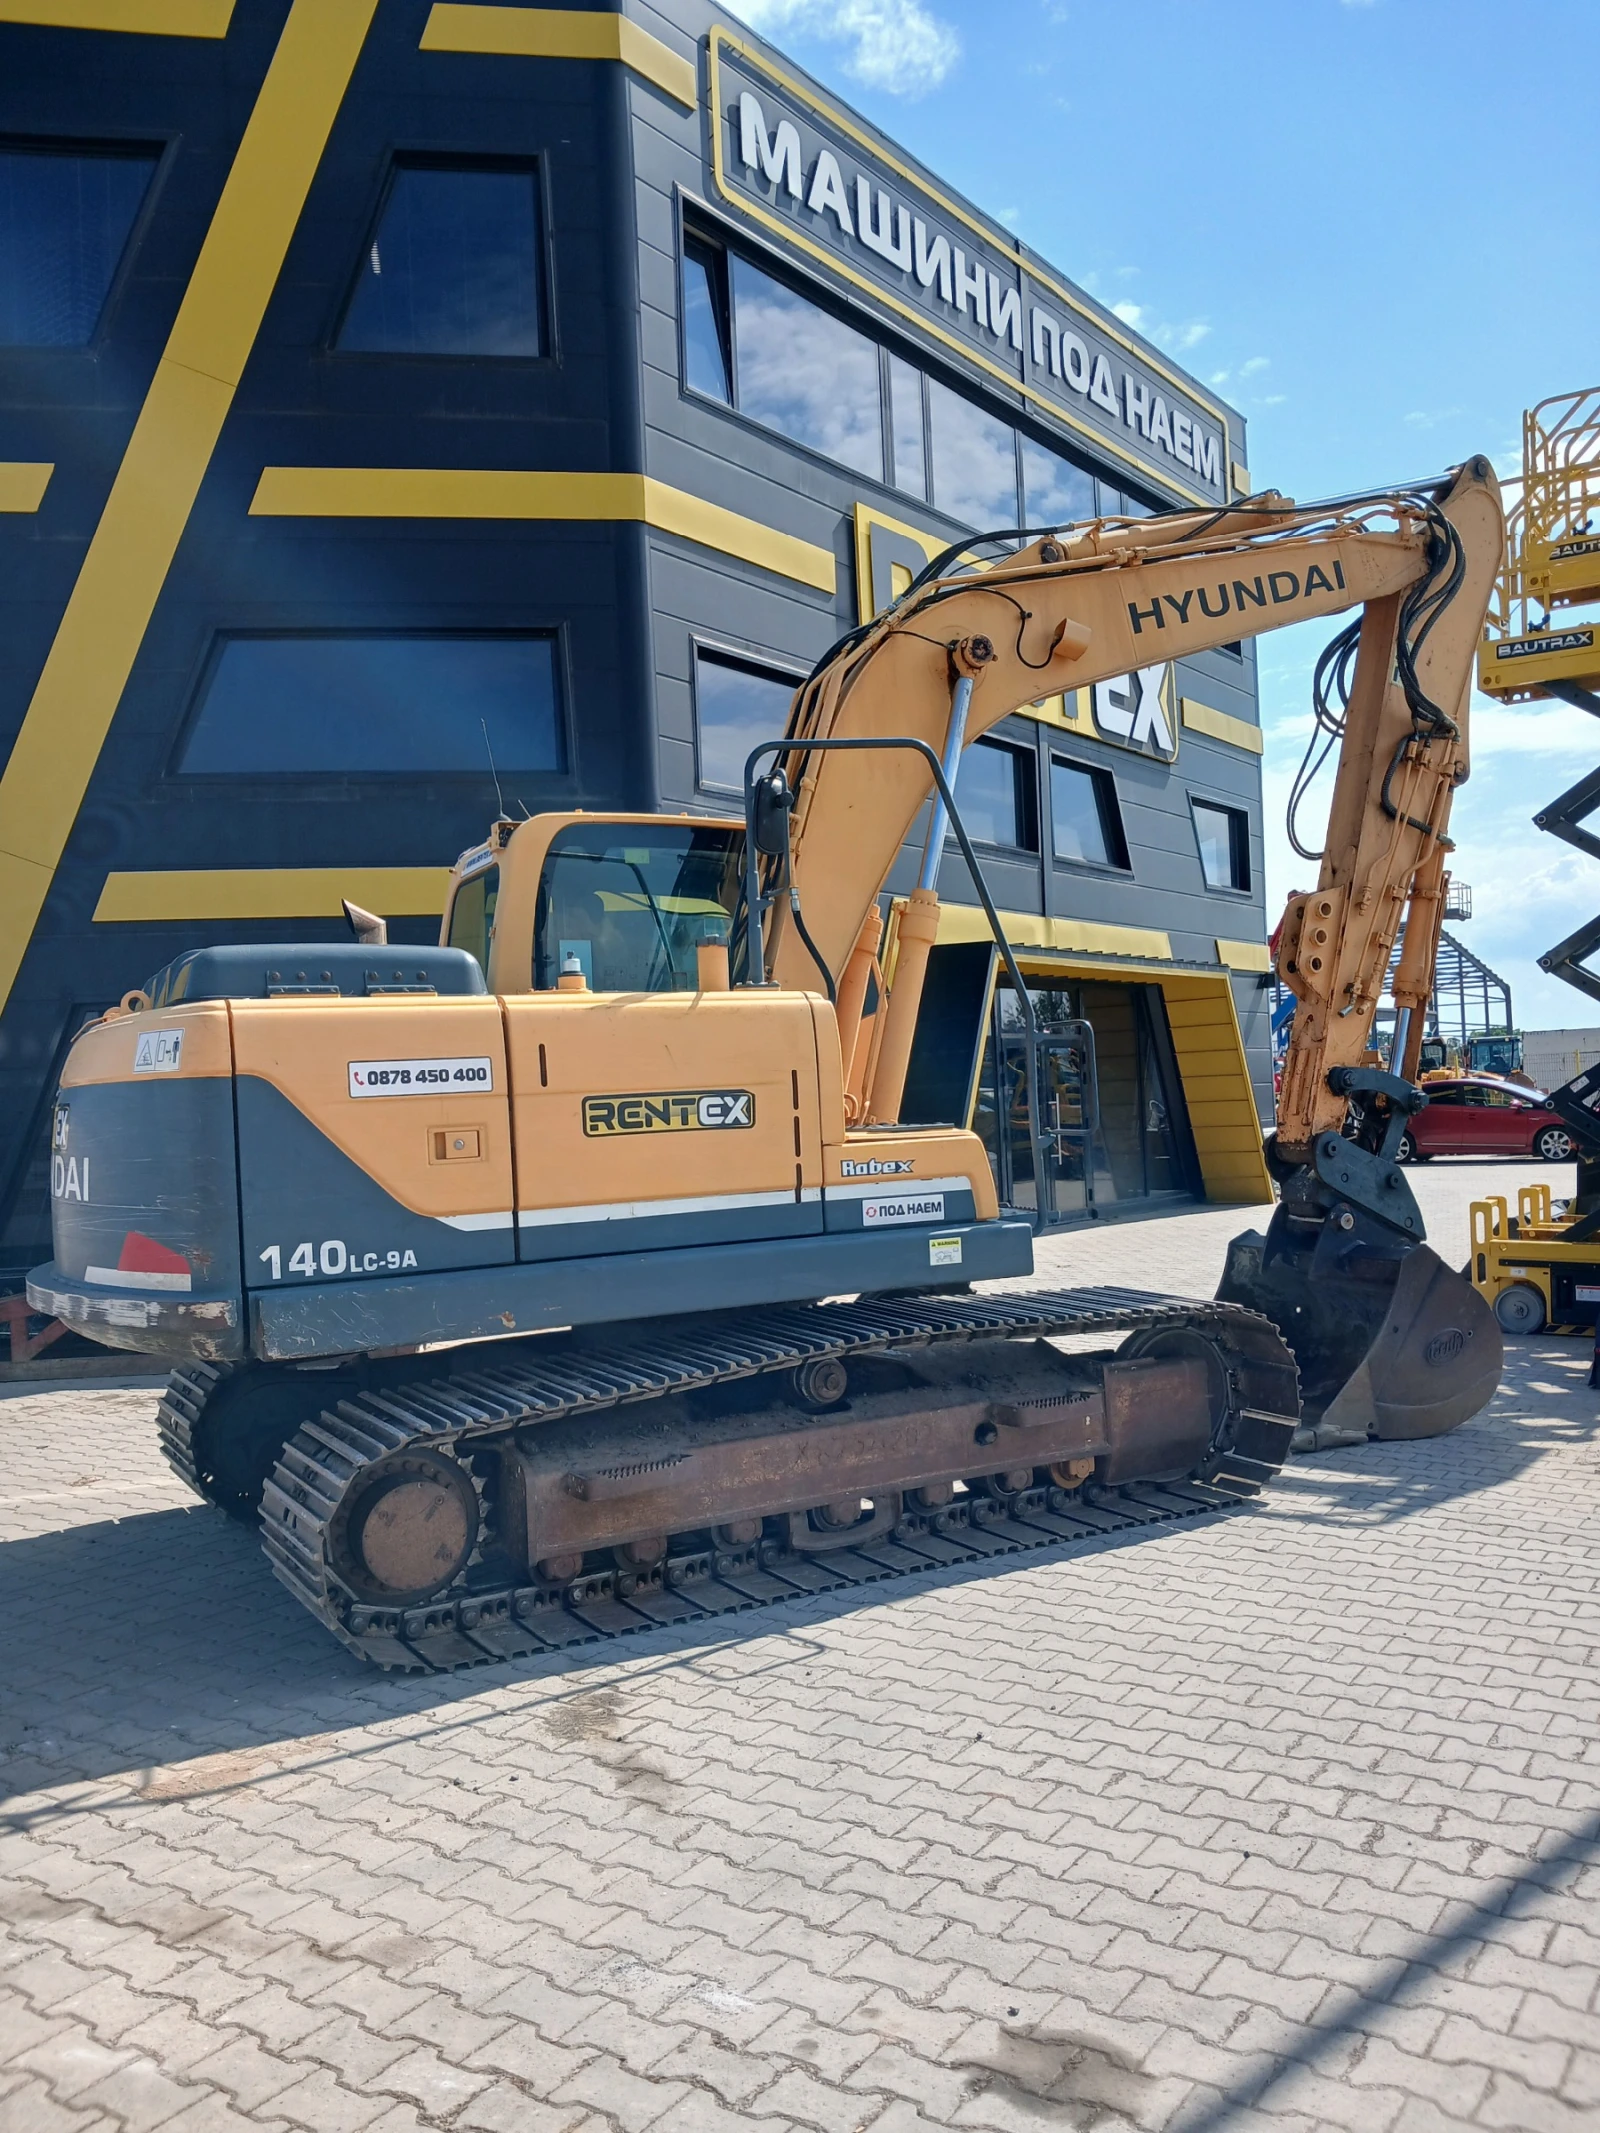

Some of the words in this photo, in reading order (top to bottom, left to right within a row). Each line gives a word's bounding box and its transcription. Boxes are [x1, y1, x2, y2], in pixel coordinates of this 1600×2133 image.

[739, 91, 1024, 352] МАШИНИ
[1032, 306, 1120, 418] ПОД
[1125, 373, 1221, 487] НАЕМ
[1128, 560, 1346, 634] HYUNDAI
[1498, 632, 1591, 656] BAUTRAX
[367, 1070, 412, 1086] 0878
[415, 1069, 450, 1083] 450
[453, 1067, 487, 1081] 400
[589, 1096, 749, 1132] RENTEX
[51, 1155, 89, 1202] DAI
[879, 1205, 905, 1217] ПОД
[907, 1201, 942, 1214] НАЕМ
